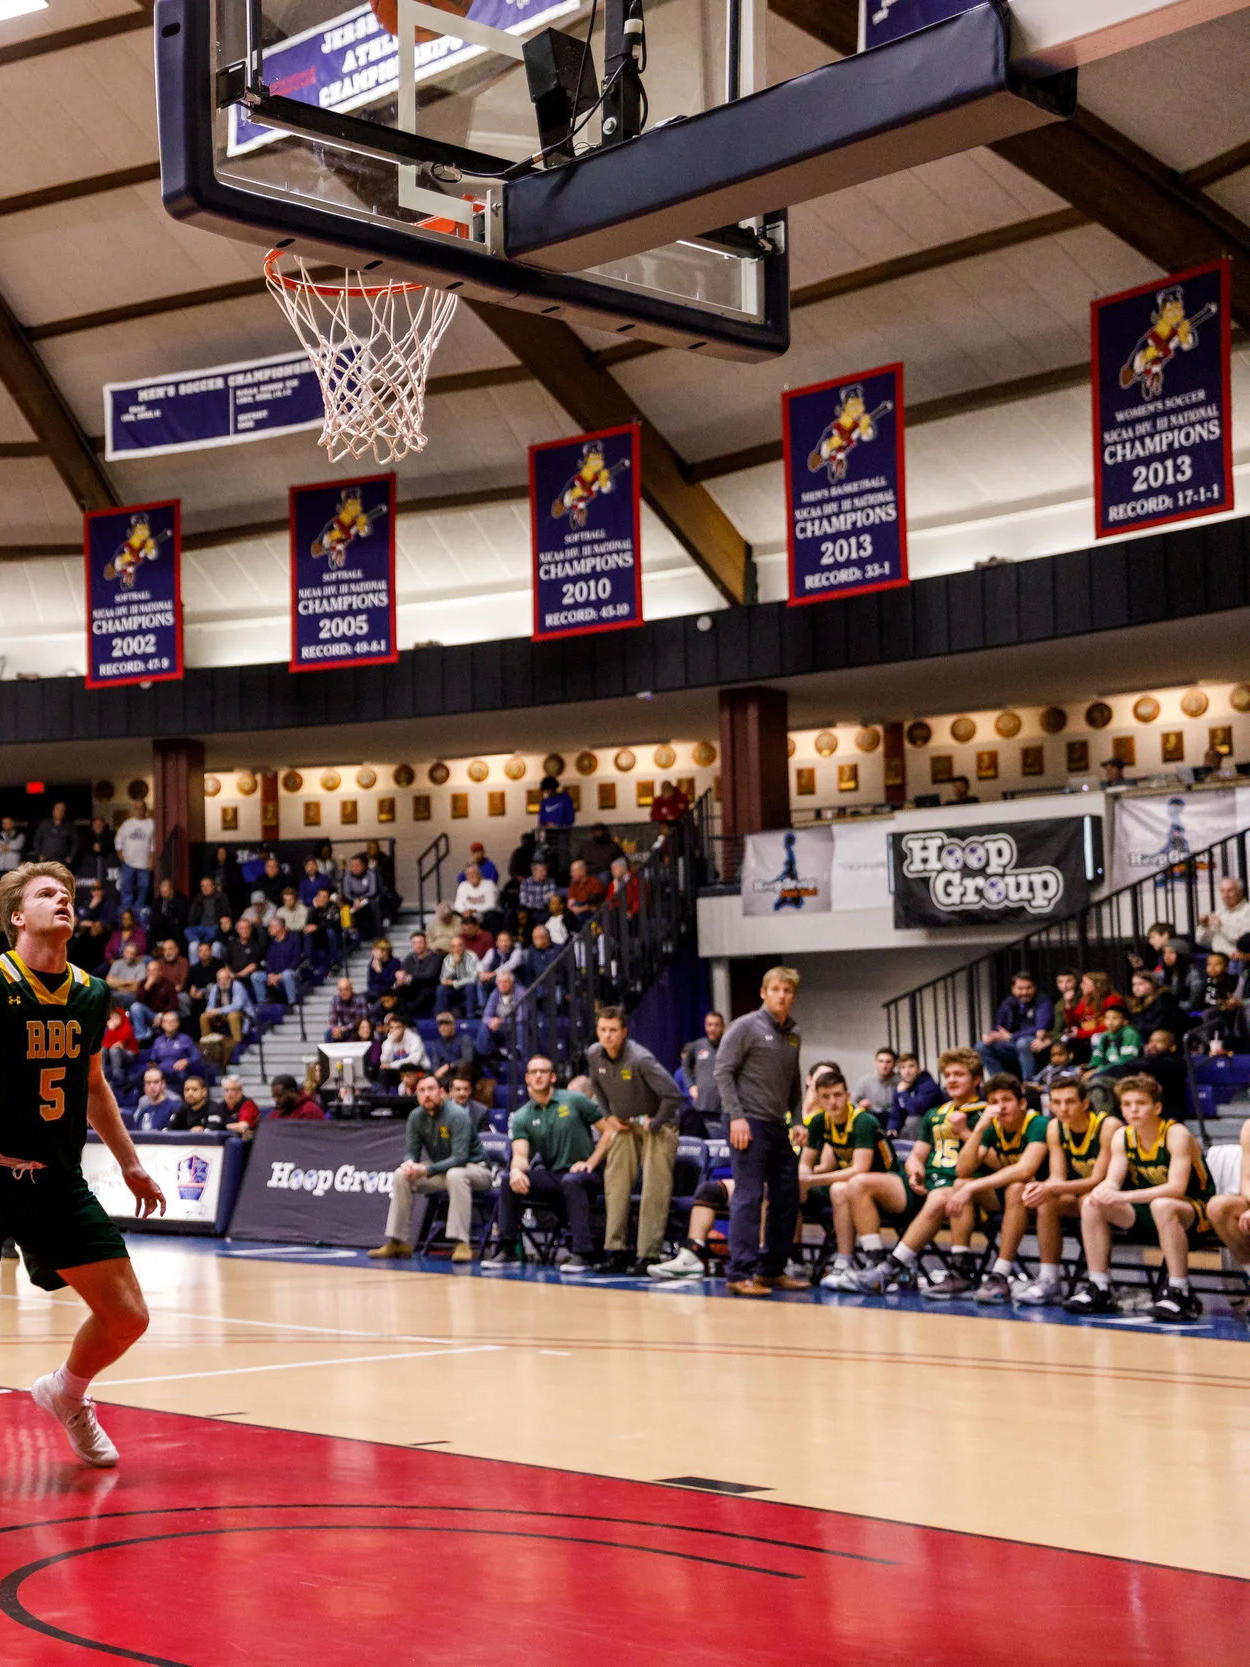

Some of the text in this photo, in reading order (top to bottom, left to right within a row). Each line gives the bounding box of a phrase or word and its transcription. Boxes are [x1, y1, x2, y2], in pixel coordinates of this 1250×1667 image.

[321, 12, 384, 54] JERSE
[342, 34, 398, 74] ATHL
[138, 384, 176, 402] MEN'S
[178, 377, 225, 396] SOCCER
[228, 360, 314, 388] CHAMPIONSH
[1115, 389, 1206, 422] WOMEN'S SOCCER
[1103, 427, 1134, 444] NJCAA
[1156, 416, 1168, 431] III
[1170, 403, 1220, 427] NATIONAL
[1104, 419, 1221, 465] CHAMPIONS
[1132, 455, 1192, 493] 2013
[1108, 483, 1219, 522] RECORD: 17-1-1
[796, 503, 896, 539] CHAMPIONS
[820, 533, 872, 565] 2013
[322, 569, 364, 582] SOFTBALL
[539, 551, 634, 580] CHAMPIONS
[805, 567, 863, 589] RECORD:
[339, 582, 348, 594] III
[350, 579, 387, 593] NATIONAL
[562, 577, 611, 605] 2010
[298, 592, 389, 615] CHAMPIONS
[545, 607, 598, 627] RECORD:
[92, 612, 175, 635] CHAMPIONS
[318, 614, 369, 639] 2005
[111, 634, 157, 657] 2002
[301, 642, 352, 659] RECORD:
[99, 660, 145, 677] RECORD:
[905, 837, 1013, 875] Hoop
[933, 870, 1059, 908] Group
[39, 1066, 66, 1121] 5
